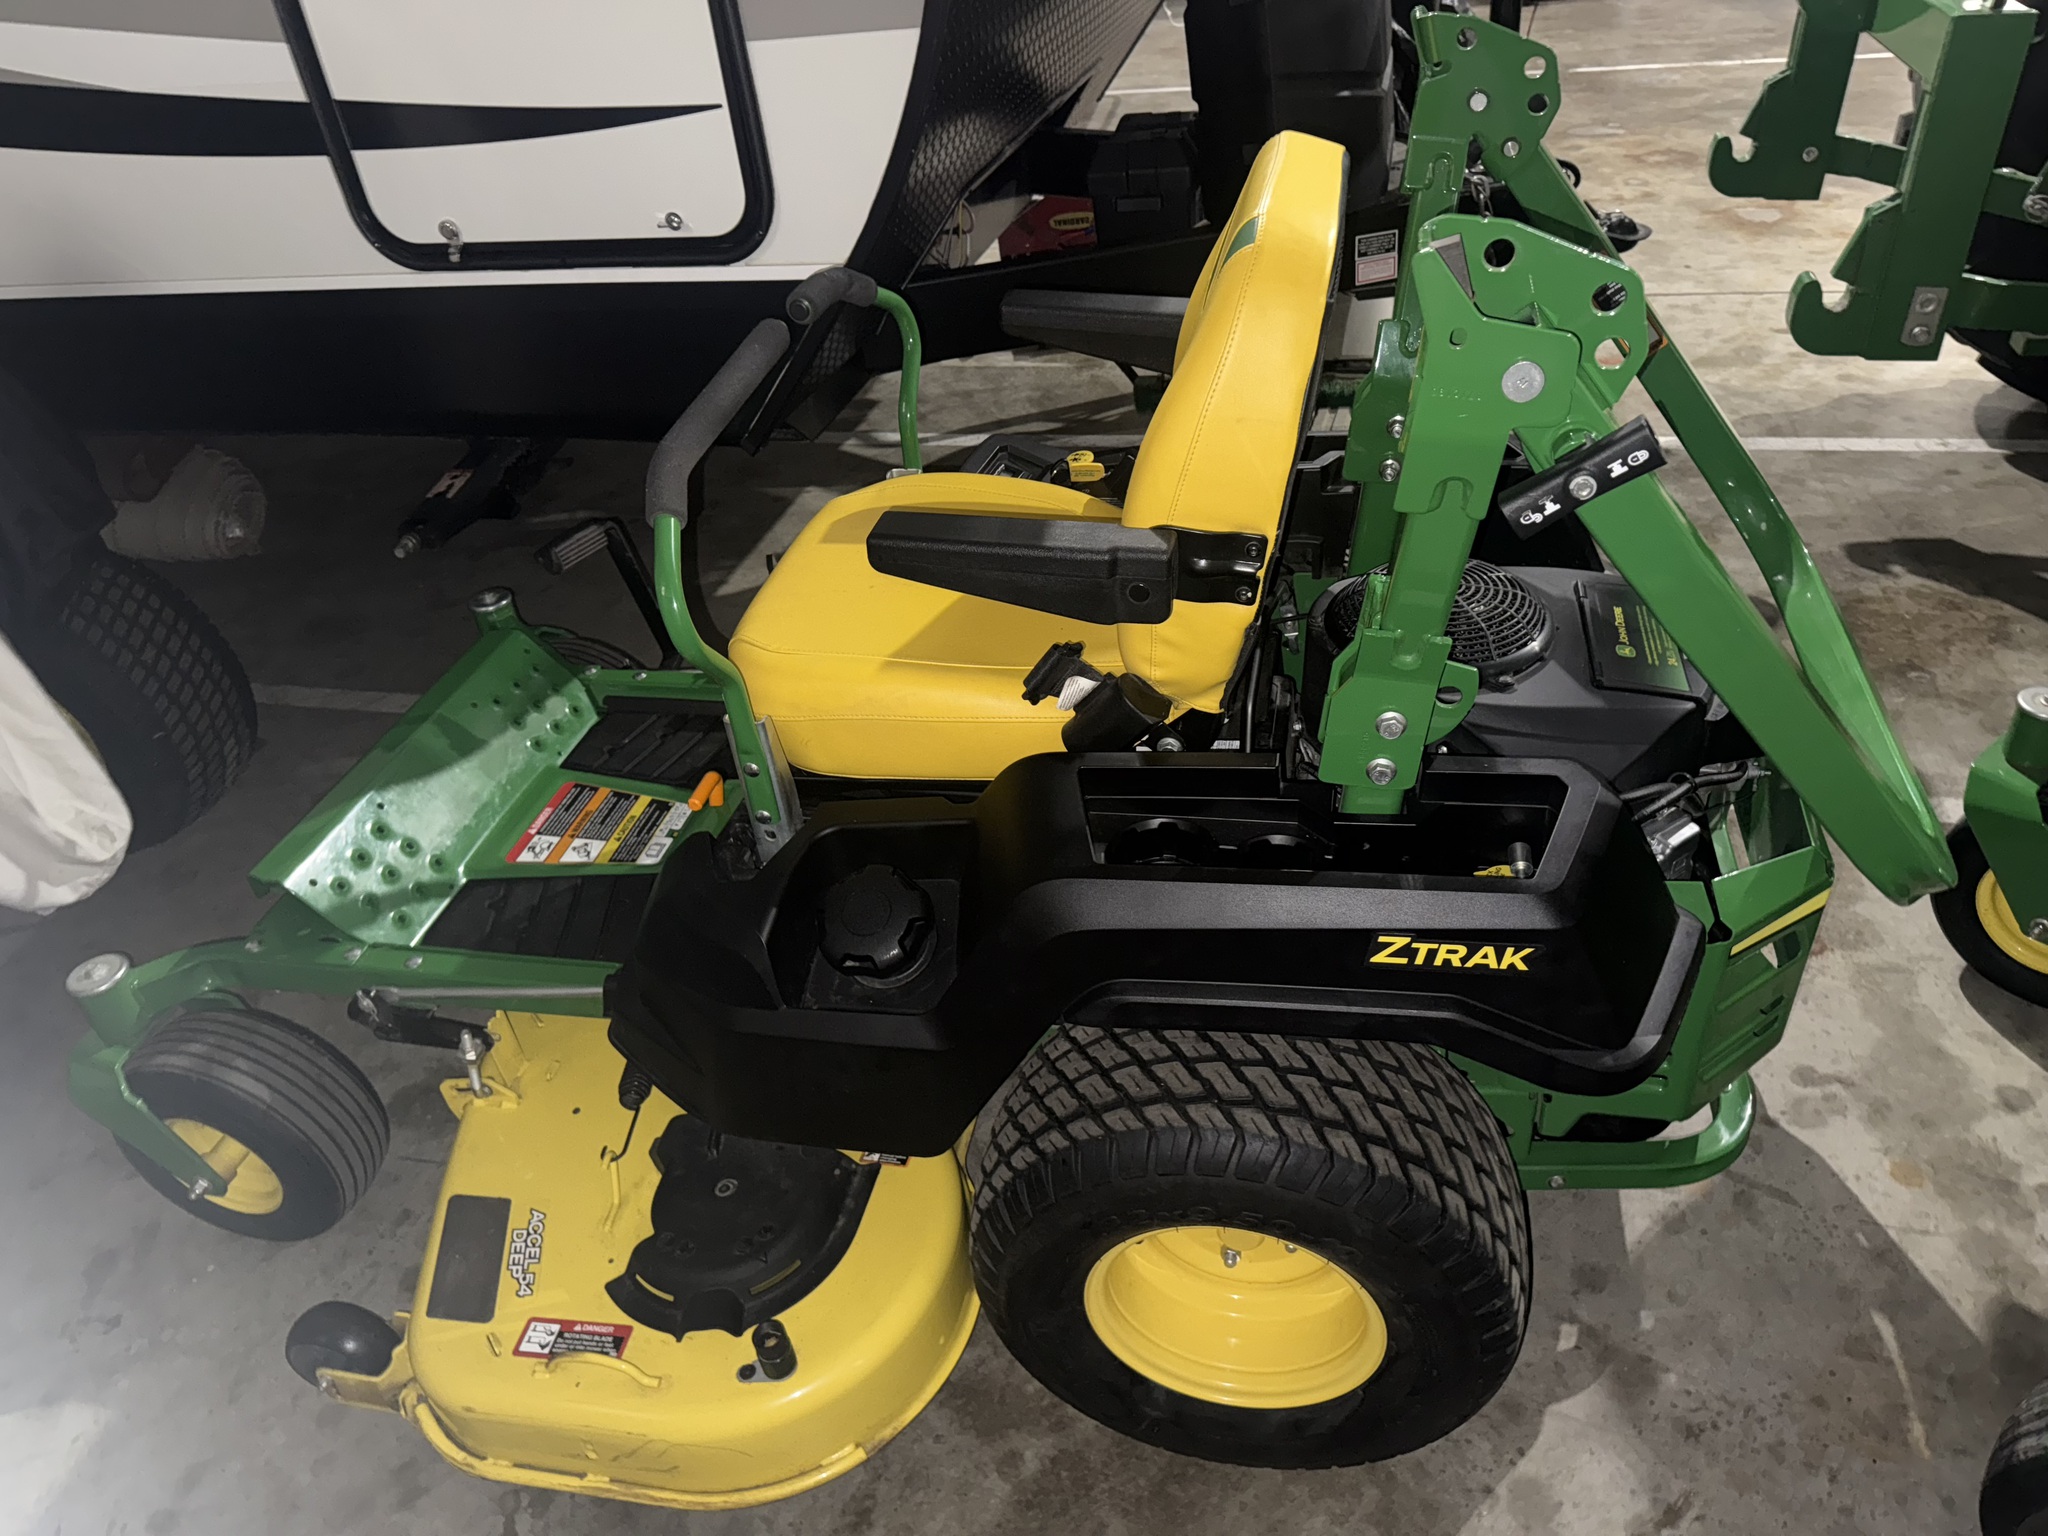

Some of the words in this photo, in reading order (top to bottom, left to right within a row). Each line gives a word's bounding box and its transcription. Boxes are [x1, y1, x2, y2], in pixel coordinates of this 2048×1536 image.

[1613, 605, 1626, 626] DEERE
[1618, 626, 1630, 645] JOHN
[618, 815, 638, 837] CAUTION
[1369, 935, 1536, 971] ZTRAK
[523, 1208, 546, 1270] ACCEL
[508, 1228, 528, 1279] DEEP
[517, 1272, 535, 1297] 54
[582, 1323, 615, 1333] DANGER
